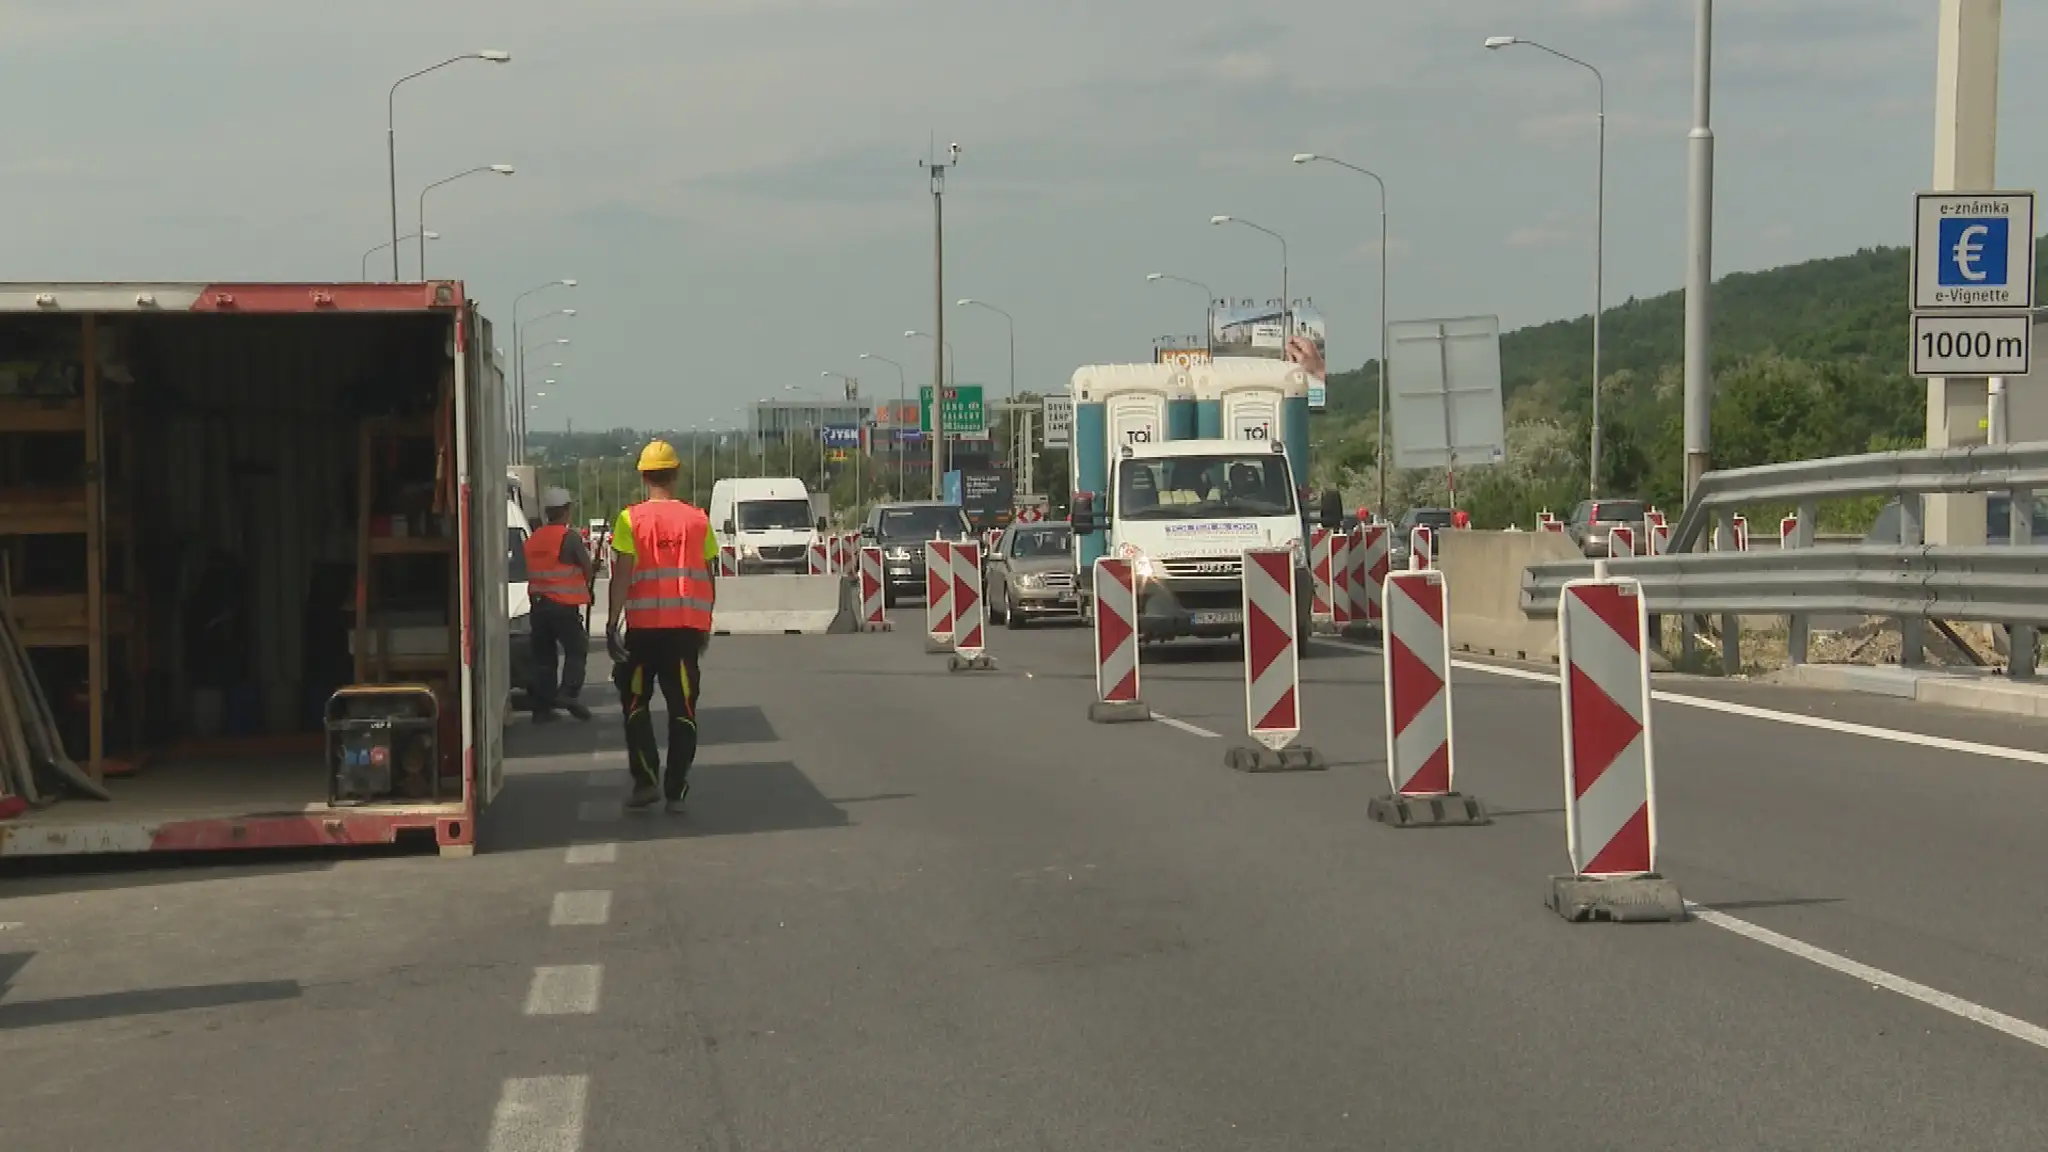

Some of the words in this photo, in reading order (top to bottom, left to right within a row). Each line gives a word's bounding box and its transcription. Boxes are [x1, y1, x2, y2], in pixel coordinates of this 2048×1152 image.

[1940, 201, 2009, 215] e-známka
[1935, 288, 2009, 304] e-Vignette
[1921, 331, 1991, 358] 1000
[1996, 336, 2022, 358] m
